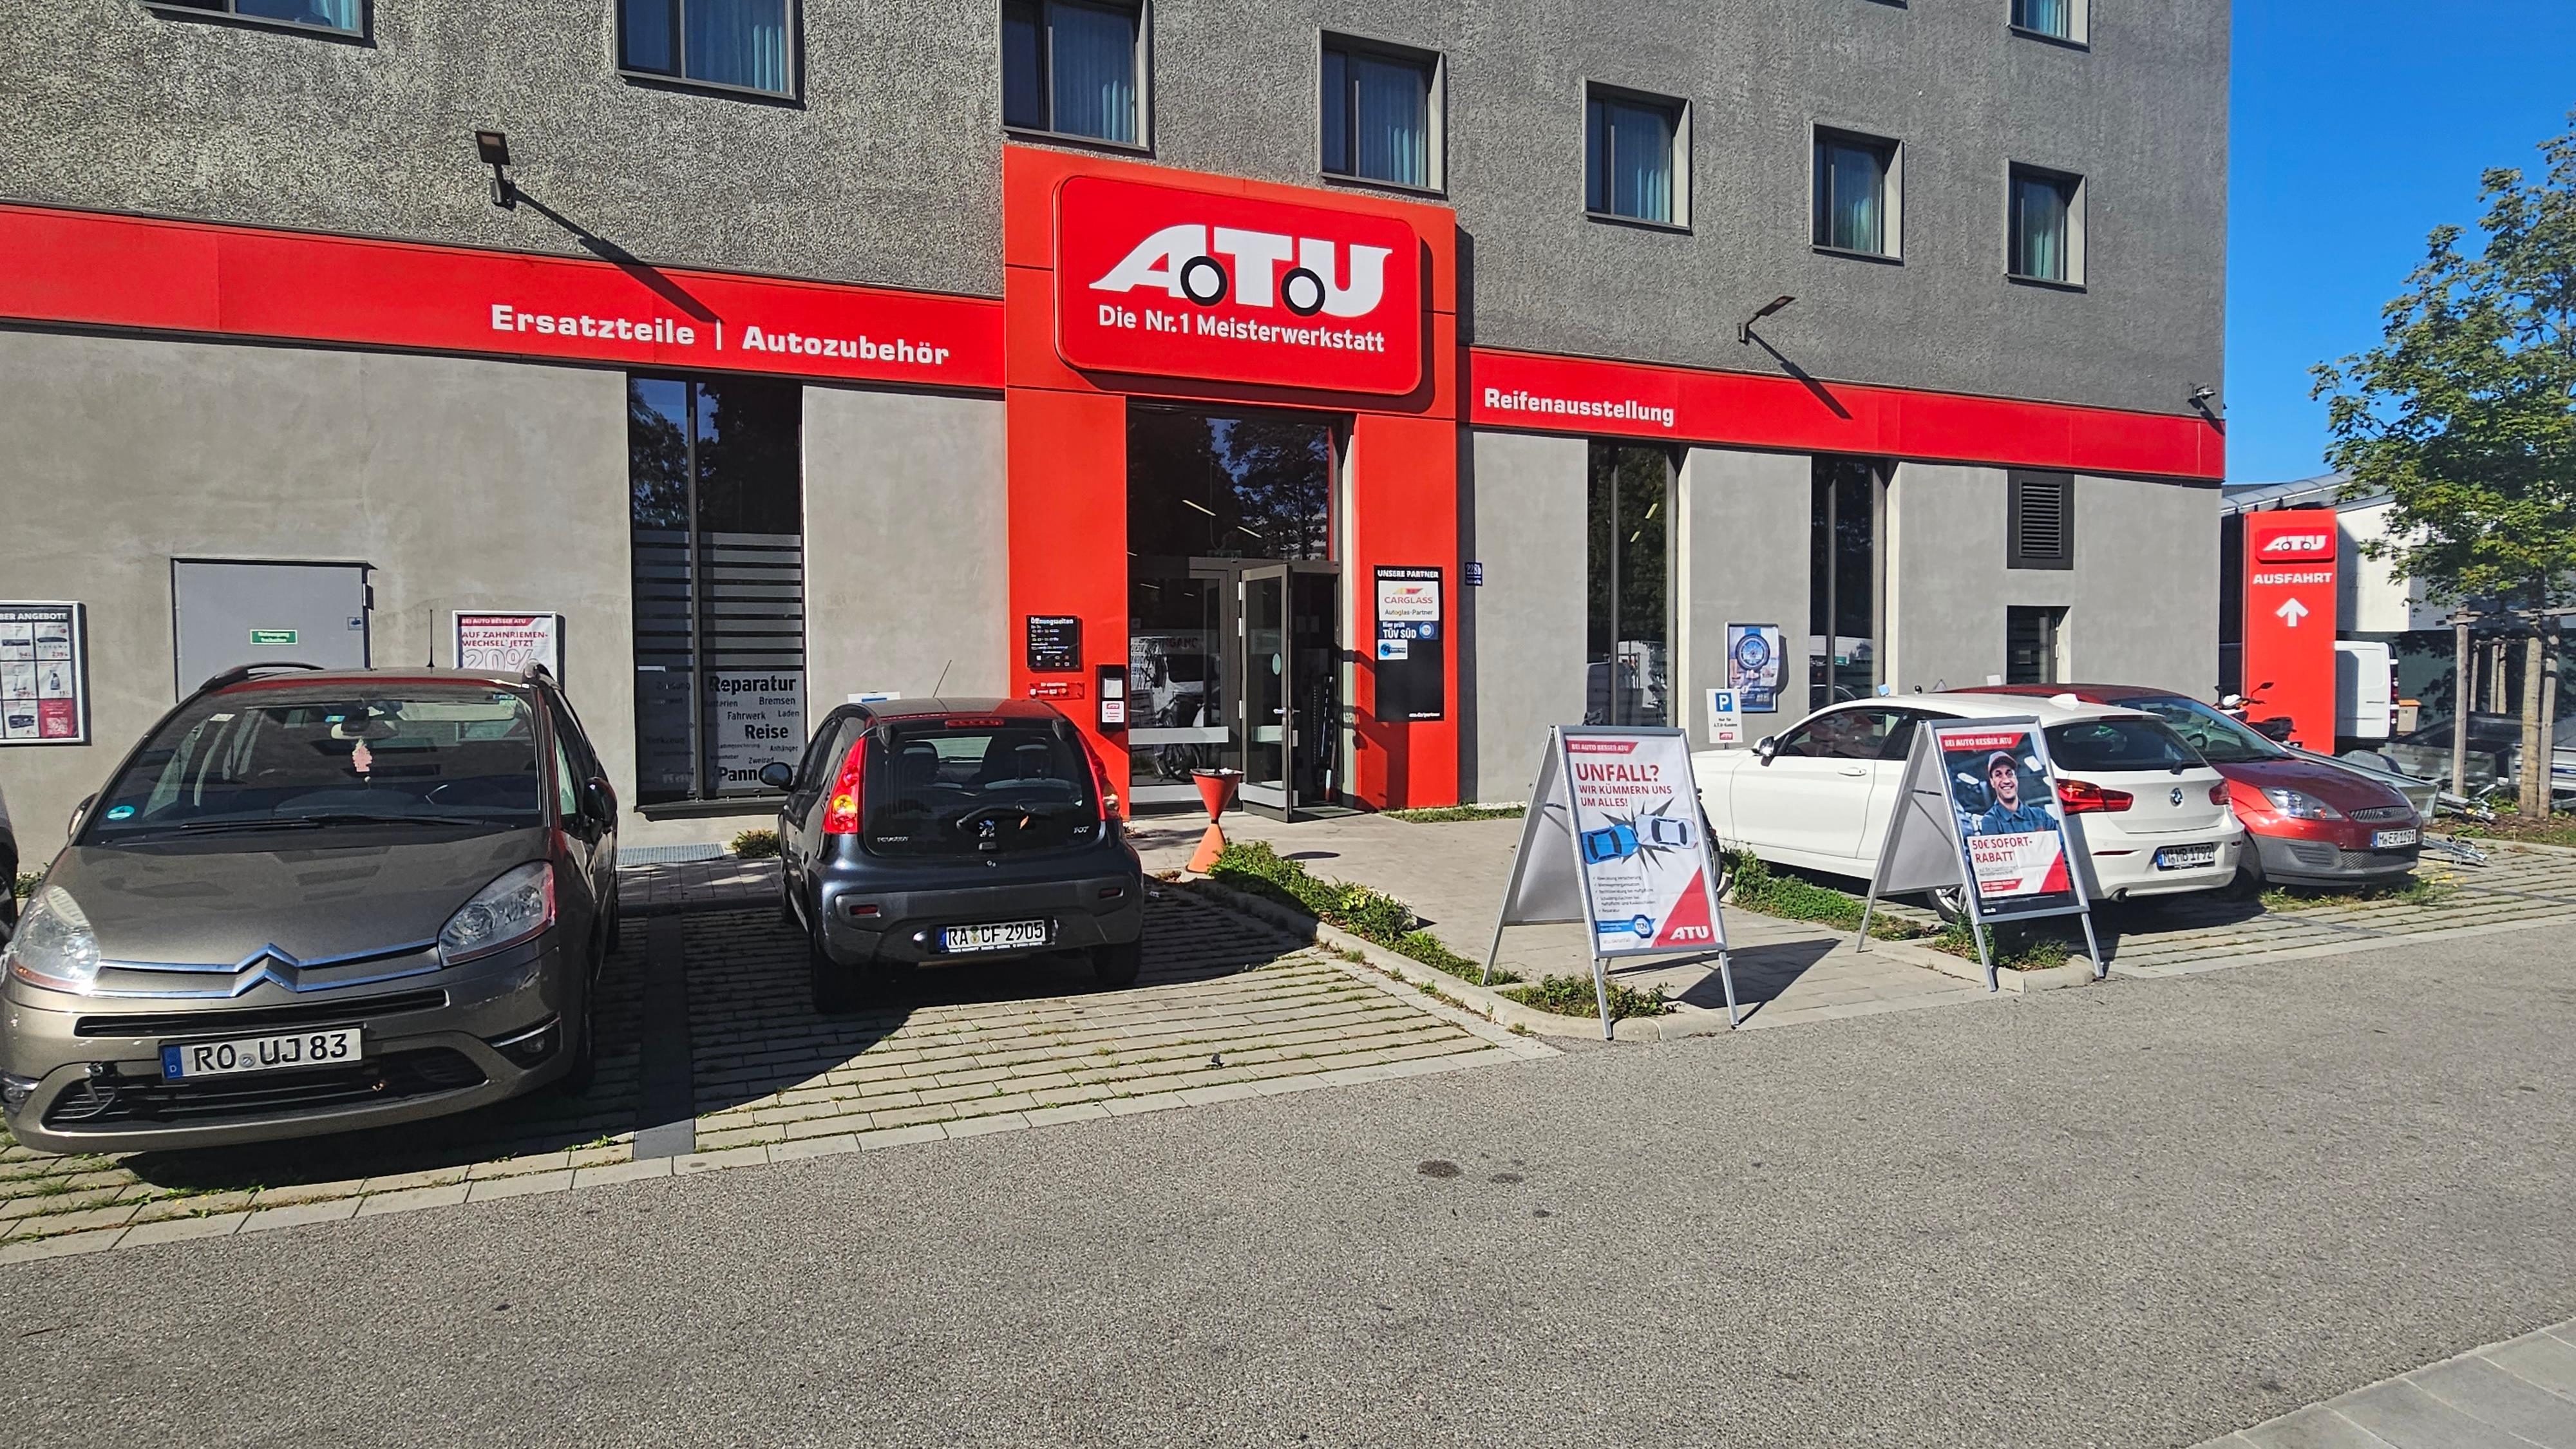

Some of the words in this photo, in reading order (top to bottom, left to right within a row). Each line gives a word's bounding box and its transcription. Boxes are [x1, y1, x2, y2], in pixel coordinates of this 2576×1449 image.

[1088, 223, 1394, 318] ATU
[491, 304, 696, 346] Ersatzteile
[742, 325, 950, 366] Autozubehör
[1098, 304, 1137, 329] Die
[1146, 309, 1189, 334] Nr.1
[1197, 314, 1385, 352] Meisterwerkstatt
[1484, 388, 1674, 428] Reifenausstellung
[2262, 535, 2327, 552] ATU
[1377, 569, 1405, 578] UNSERE
[1406, 570, 1439, 578] PARTNER
[2252, 572, 2333, 585] AUSFAHRT
[1382, 628, 1399, 639] TÜV
[1400, 628, 1417, 639] SÜD
[709, 676, 796, 695] Reparatur
[759, 697, 796, 705] Bremsen
[1719, 695, 1729, 710] P
[727, 711, 766, 721] Fahrwerk
[744, 723, 789, 739] Reise
[719, 766, 757, 782] Pann
[1575, 763, 1660, 782] UNFALL?
[1579, 785, 1597, 793] WIR
[1599, 783, 1649, 795] KÜMMERN
[1652, 785, 1672, 794] UNS
[1580, 797, 1596, 806] UM
[1598, 798, 1628, 807] ALLES!
[1074, 826, 1090, 834] 107
[1972, 840, 1989, 849] 50€
[1991, 837, 2032, 848] SOFORT-
[1975, 851, 2014, 863] RABATT
[2190, 845, 2213, 861] 1792
[948, 927, 969, 946] RA
[981, 925, 1000, 943] CF
[1005, 922, 1043, 942] 2905
[1670, 925, 1709, 940] ATU
[193, 1044, 236, 1072] RO
[259, 1037, 301, 1065] UJ
[310, 1033, 348, 1061] 83
